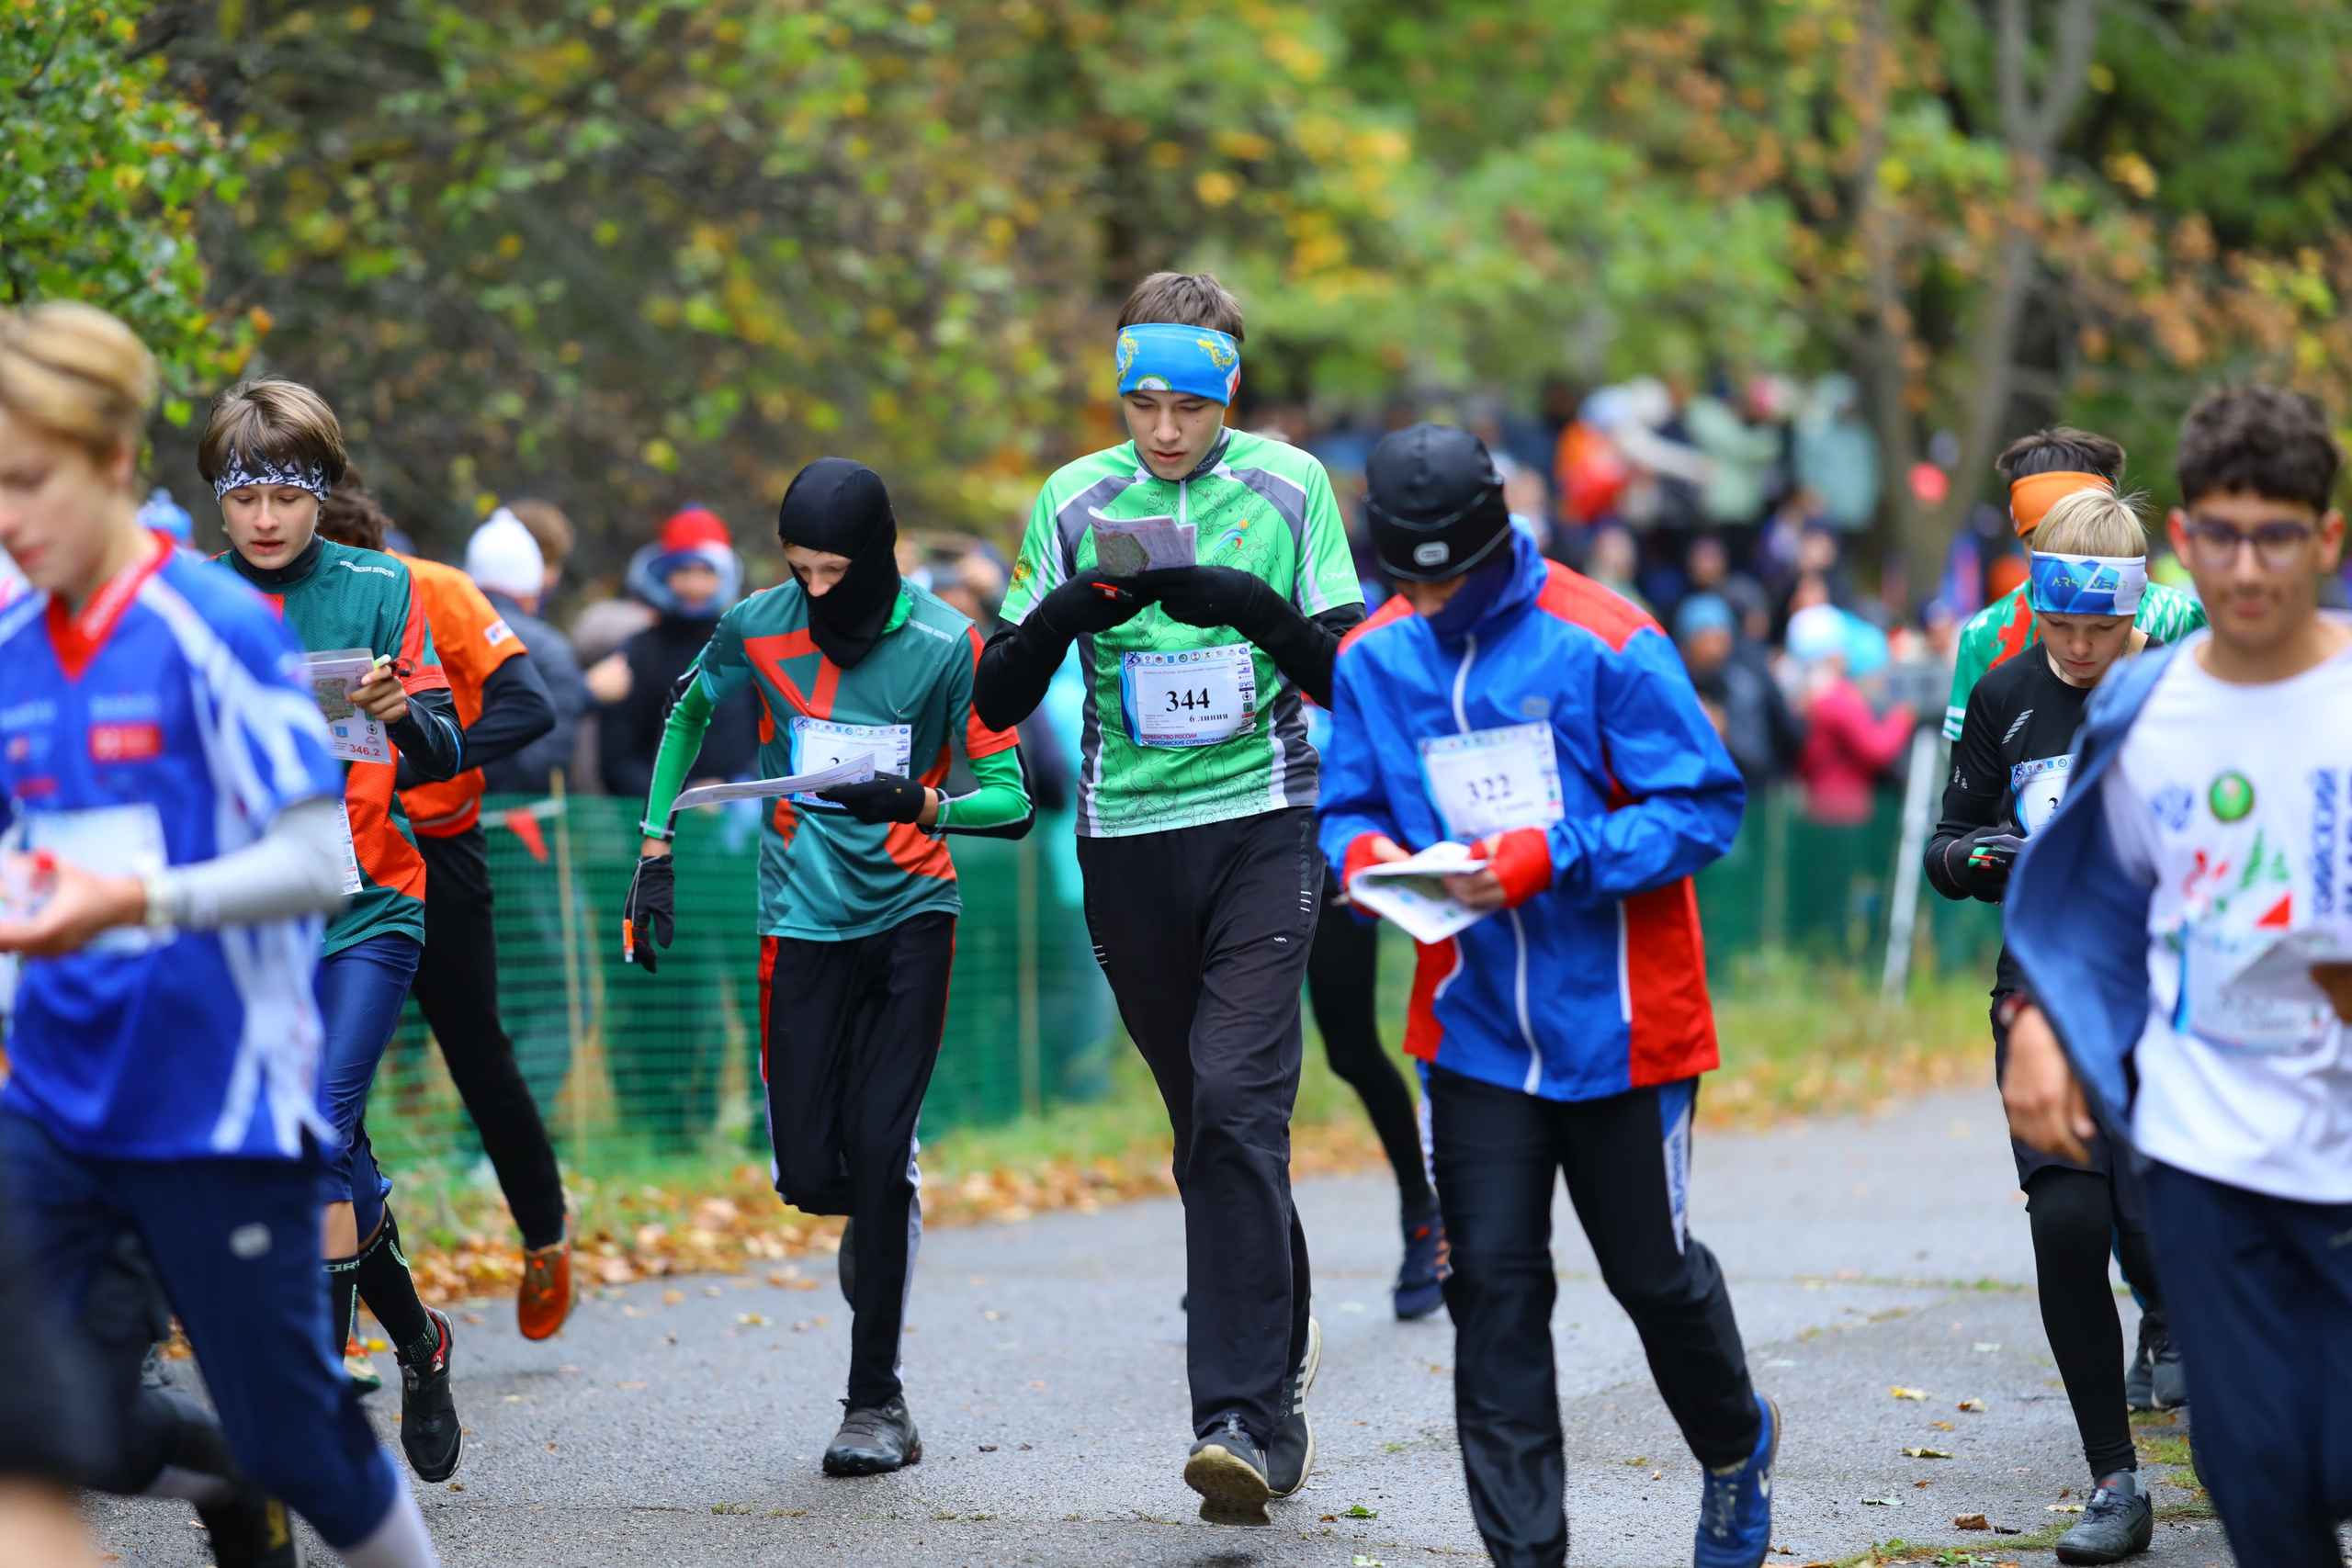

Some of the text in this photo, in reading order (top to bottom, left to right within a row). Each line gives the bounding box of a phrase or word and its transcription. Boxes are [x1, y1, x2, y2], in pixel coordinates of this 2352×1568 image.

[1165, 687, 1210, 712] 344
[1189, 714, 1195, 723] 6
[1197, 714, 1228, 722] линия
[350, 744, 380, 756] 346.2
[1467, 774, 1512, 806] 322
